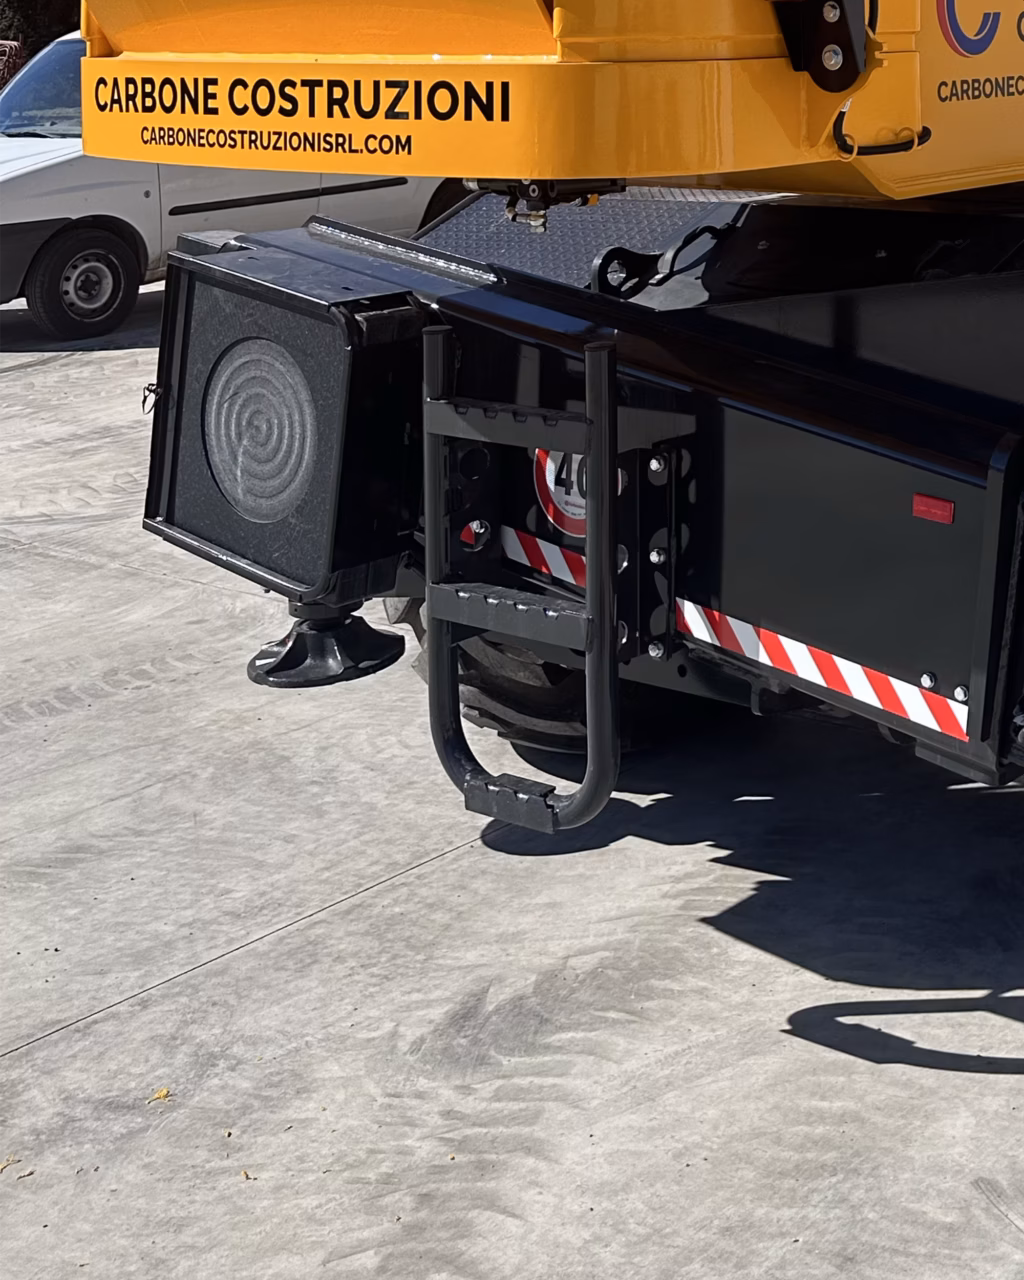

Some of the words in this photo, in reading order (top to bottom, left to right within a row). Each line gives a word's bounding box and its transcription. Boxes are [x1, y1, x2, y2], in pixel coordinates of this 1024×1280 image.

[94, 76, 219, 117] CARBONE
[228, 77, 510, 123] COSTRUZIONI
[140, 125, 412, 156] CARBONECOSTRUZIONISRL.COM
